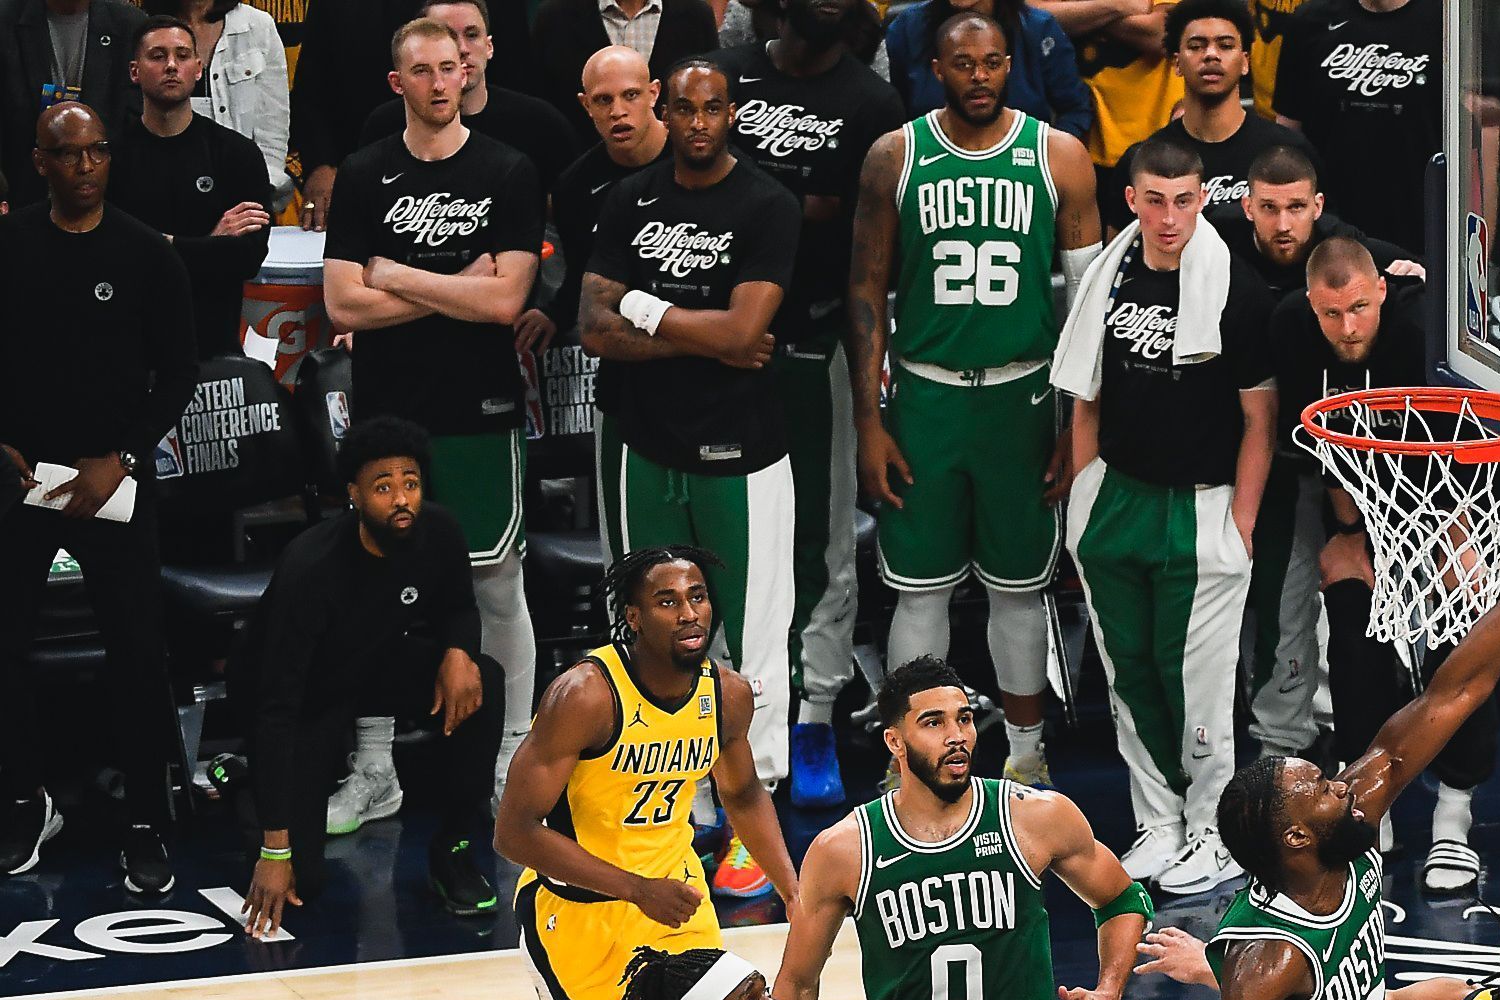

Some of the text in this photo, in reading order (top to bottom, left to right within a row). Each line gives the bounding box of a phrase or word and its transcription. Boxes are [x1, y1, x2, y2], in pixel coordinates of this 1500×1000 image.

[1320, 43, 1430, 79] Different
[1347, 69, 1413, 96] Here
[734, 99, 844, 136] Different
[756, 127, 825, 157] Here
[383, 192, 493, 234] Different
[917, 176, 1034, 236] BOSTON
[413, 217, 479, 247] Here
[631, 221, 734, 259] Different
[659, 248, 718, 278] Here
[932, 239, 1021, 306] 26
[1107, 302, 1179, 339] Differe
[543, 345, 600, 377] EASTER
[1129, 328, 1175, 359] Her
[184, 377, 245, 414] STERN
[546, 373, 596, 406] CONFE
[181, 402, 281, 444] CONFERENCE
[550, 403, 594, 436] FINAL
[186, 438, 240, 474] FINALS
[610, 736, 715, 775] INDIANA
[623, 778, 687, 825] 23
[973, 831, 1002, 848] VISTA
[975, 843, 1003, 858] PRINT
[1358, 867, 1378, 893] VISTA
[875, 870, 1015, 949] BOSTON
